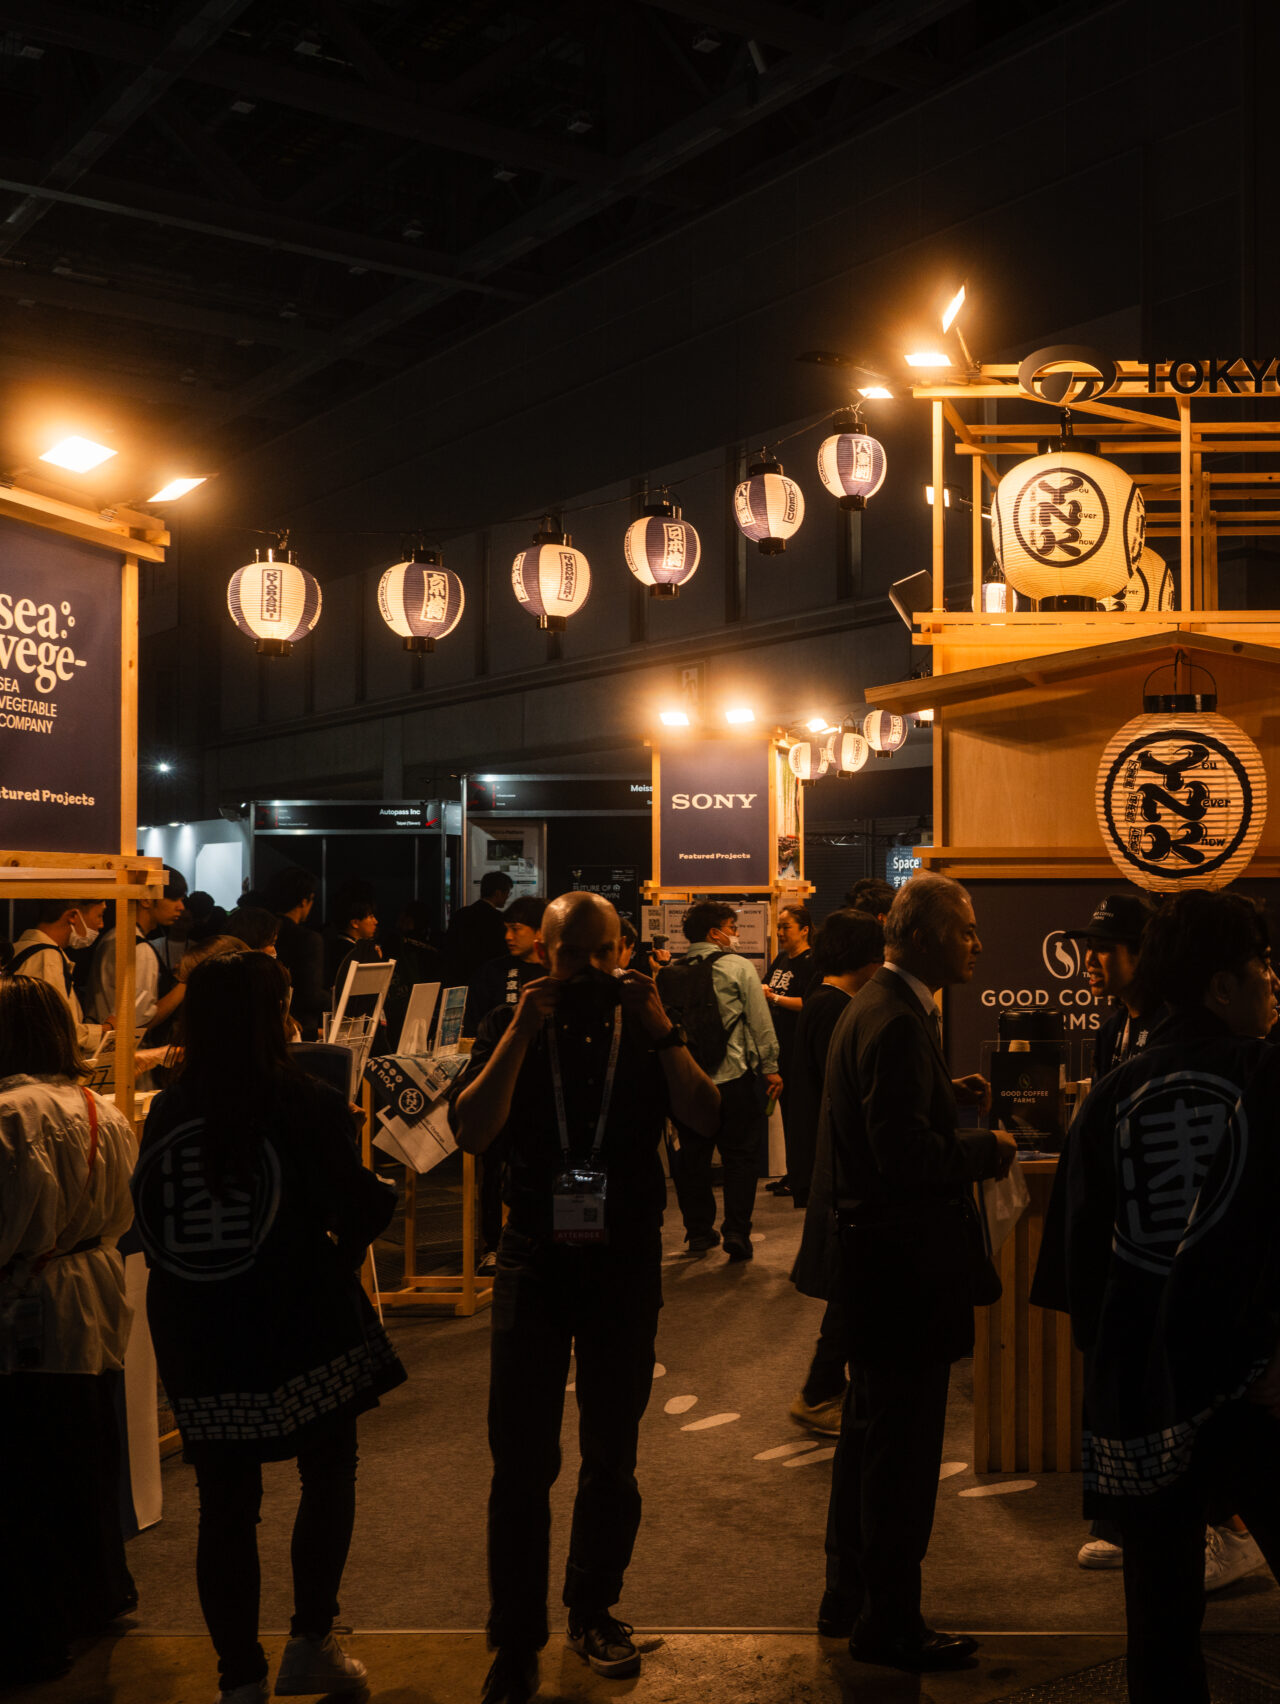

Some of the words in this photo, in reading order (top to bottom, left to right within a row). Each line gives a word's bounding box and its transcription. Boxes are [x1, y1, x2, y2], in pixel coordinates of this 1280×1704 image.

[785, 481, 798, 521] YAESU
[666, 525, 684, 568] 日本橋
[264, 571, 280, 620] KYOBASHI
[427, 572, 446, 620] 京橋
[0, 712, 54, 734] COMPANY
[42, 789, 96, 807] Projects
[672, 793, 758, 810] SONY
[379, 808, 409, 816] Autopass
[715, 852, 752, 860] Projects
[893, 857, 919, 873] Space
[981, 989, 1049, 1007] GOOD
